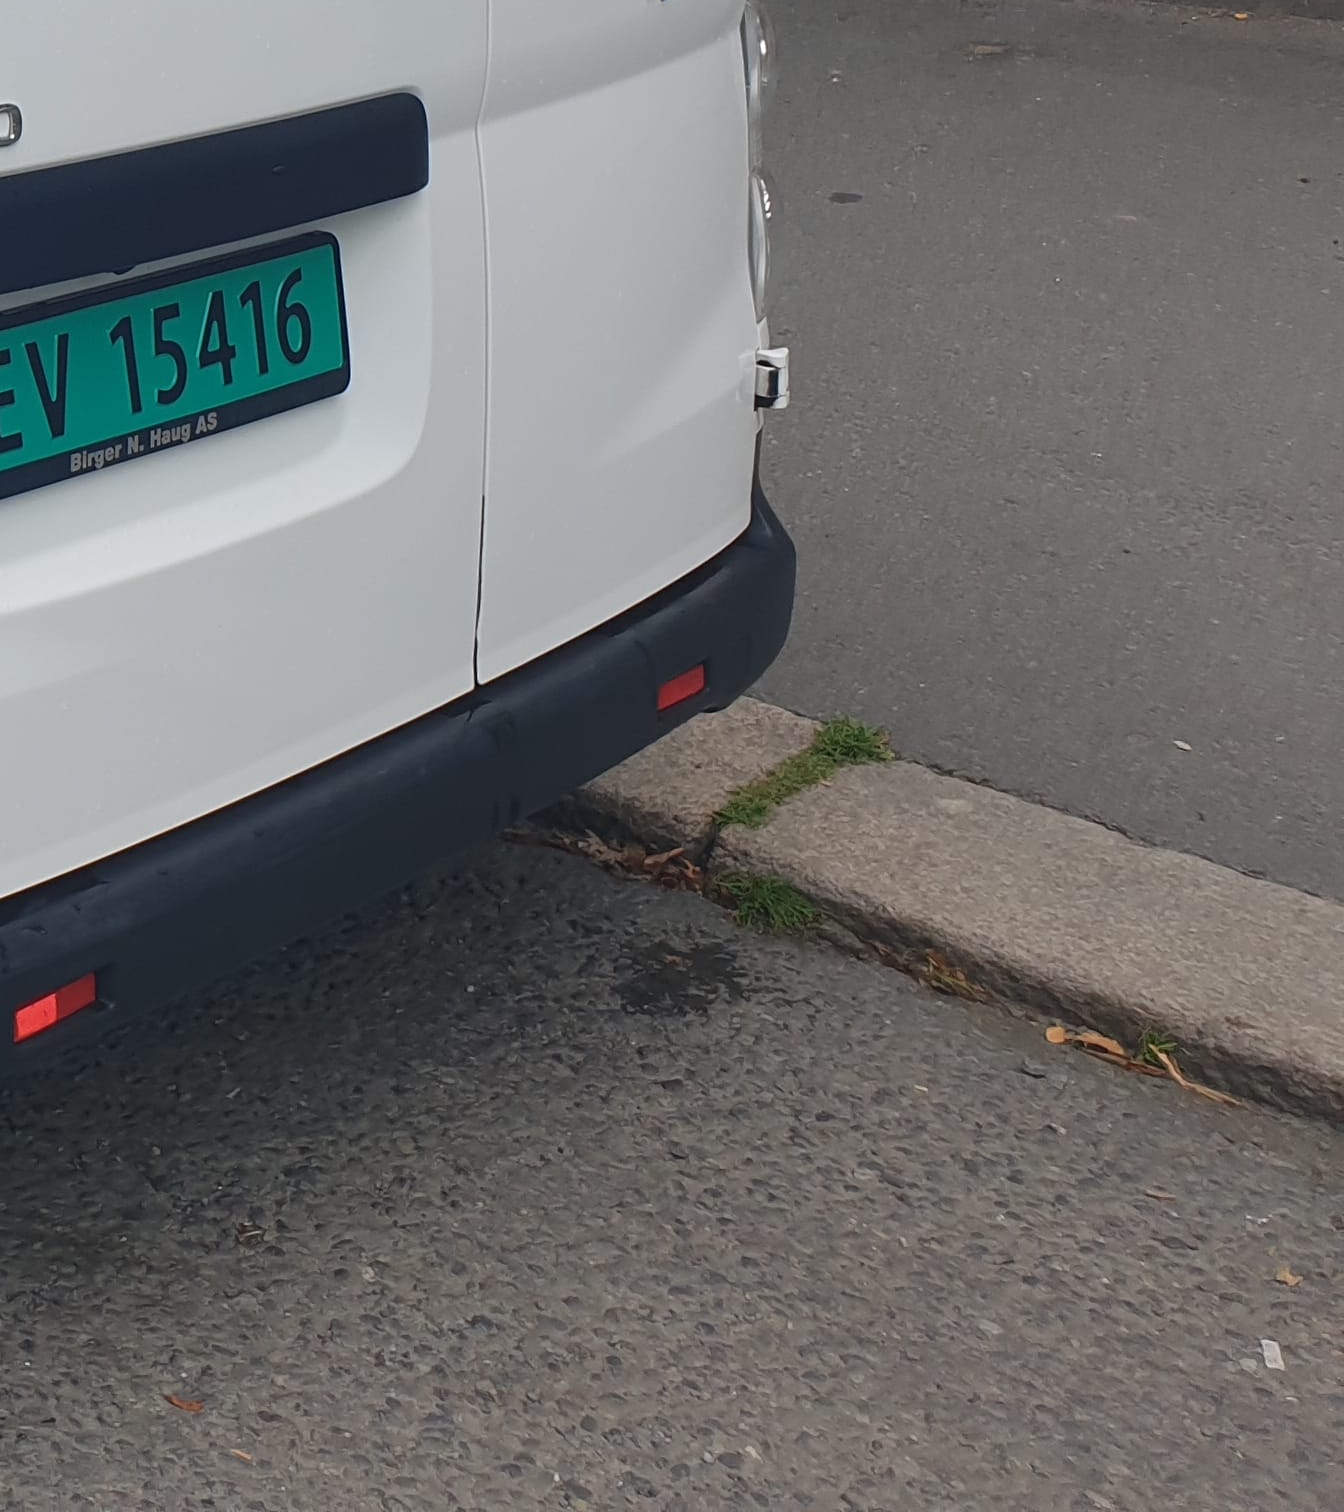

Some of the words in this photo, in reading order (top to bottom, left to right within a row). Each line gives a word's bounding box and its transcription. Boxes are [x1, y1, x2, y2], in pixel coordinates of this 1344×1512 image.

[108, 268, 312, 415] 15416
[70, 443, 122, 473] Birger
[127, 435, 144, 455] N.
[150, 423, 191, 449] Haug
[195, 412, 218, 435] AS
